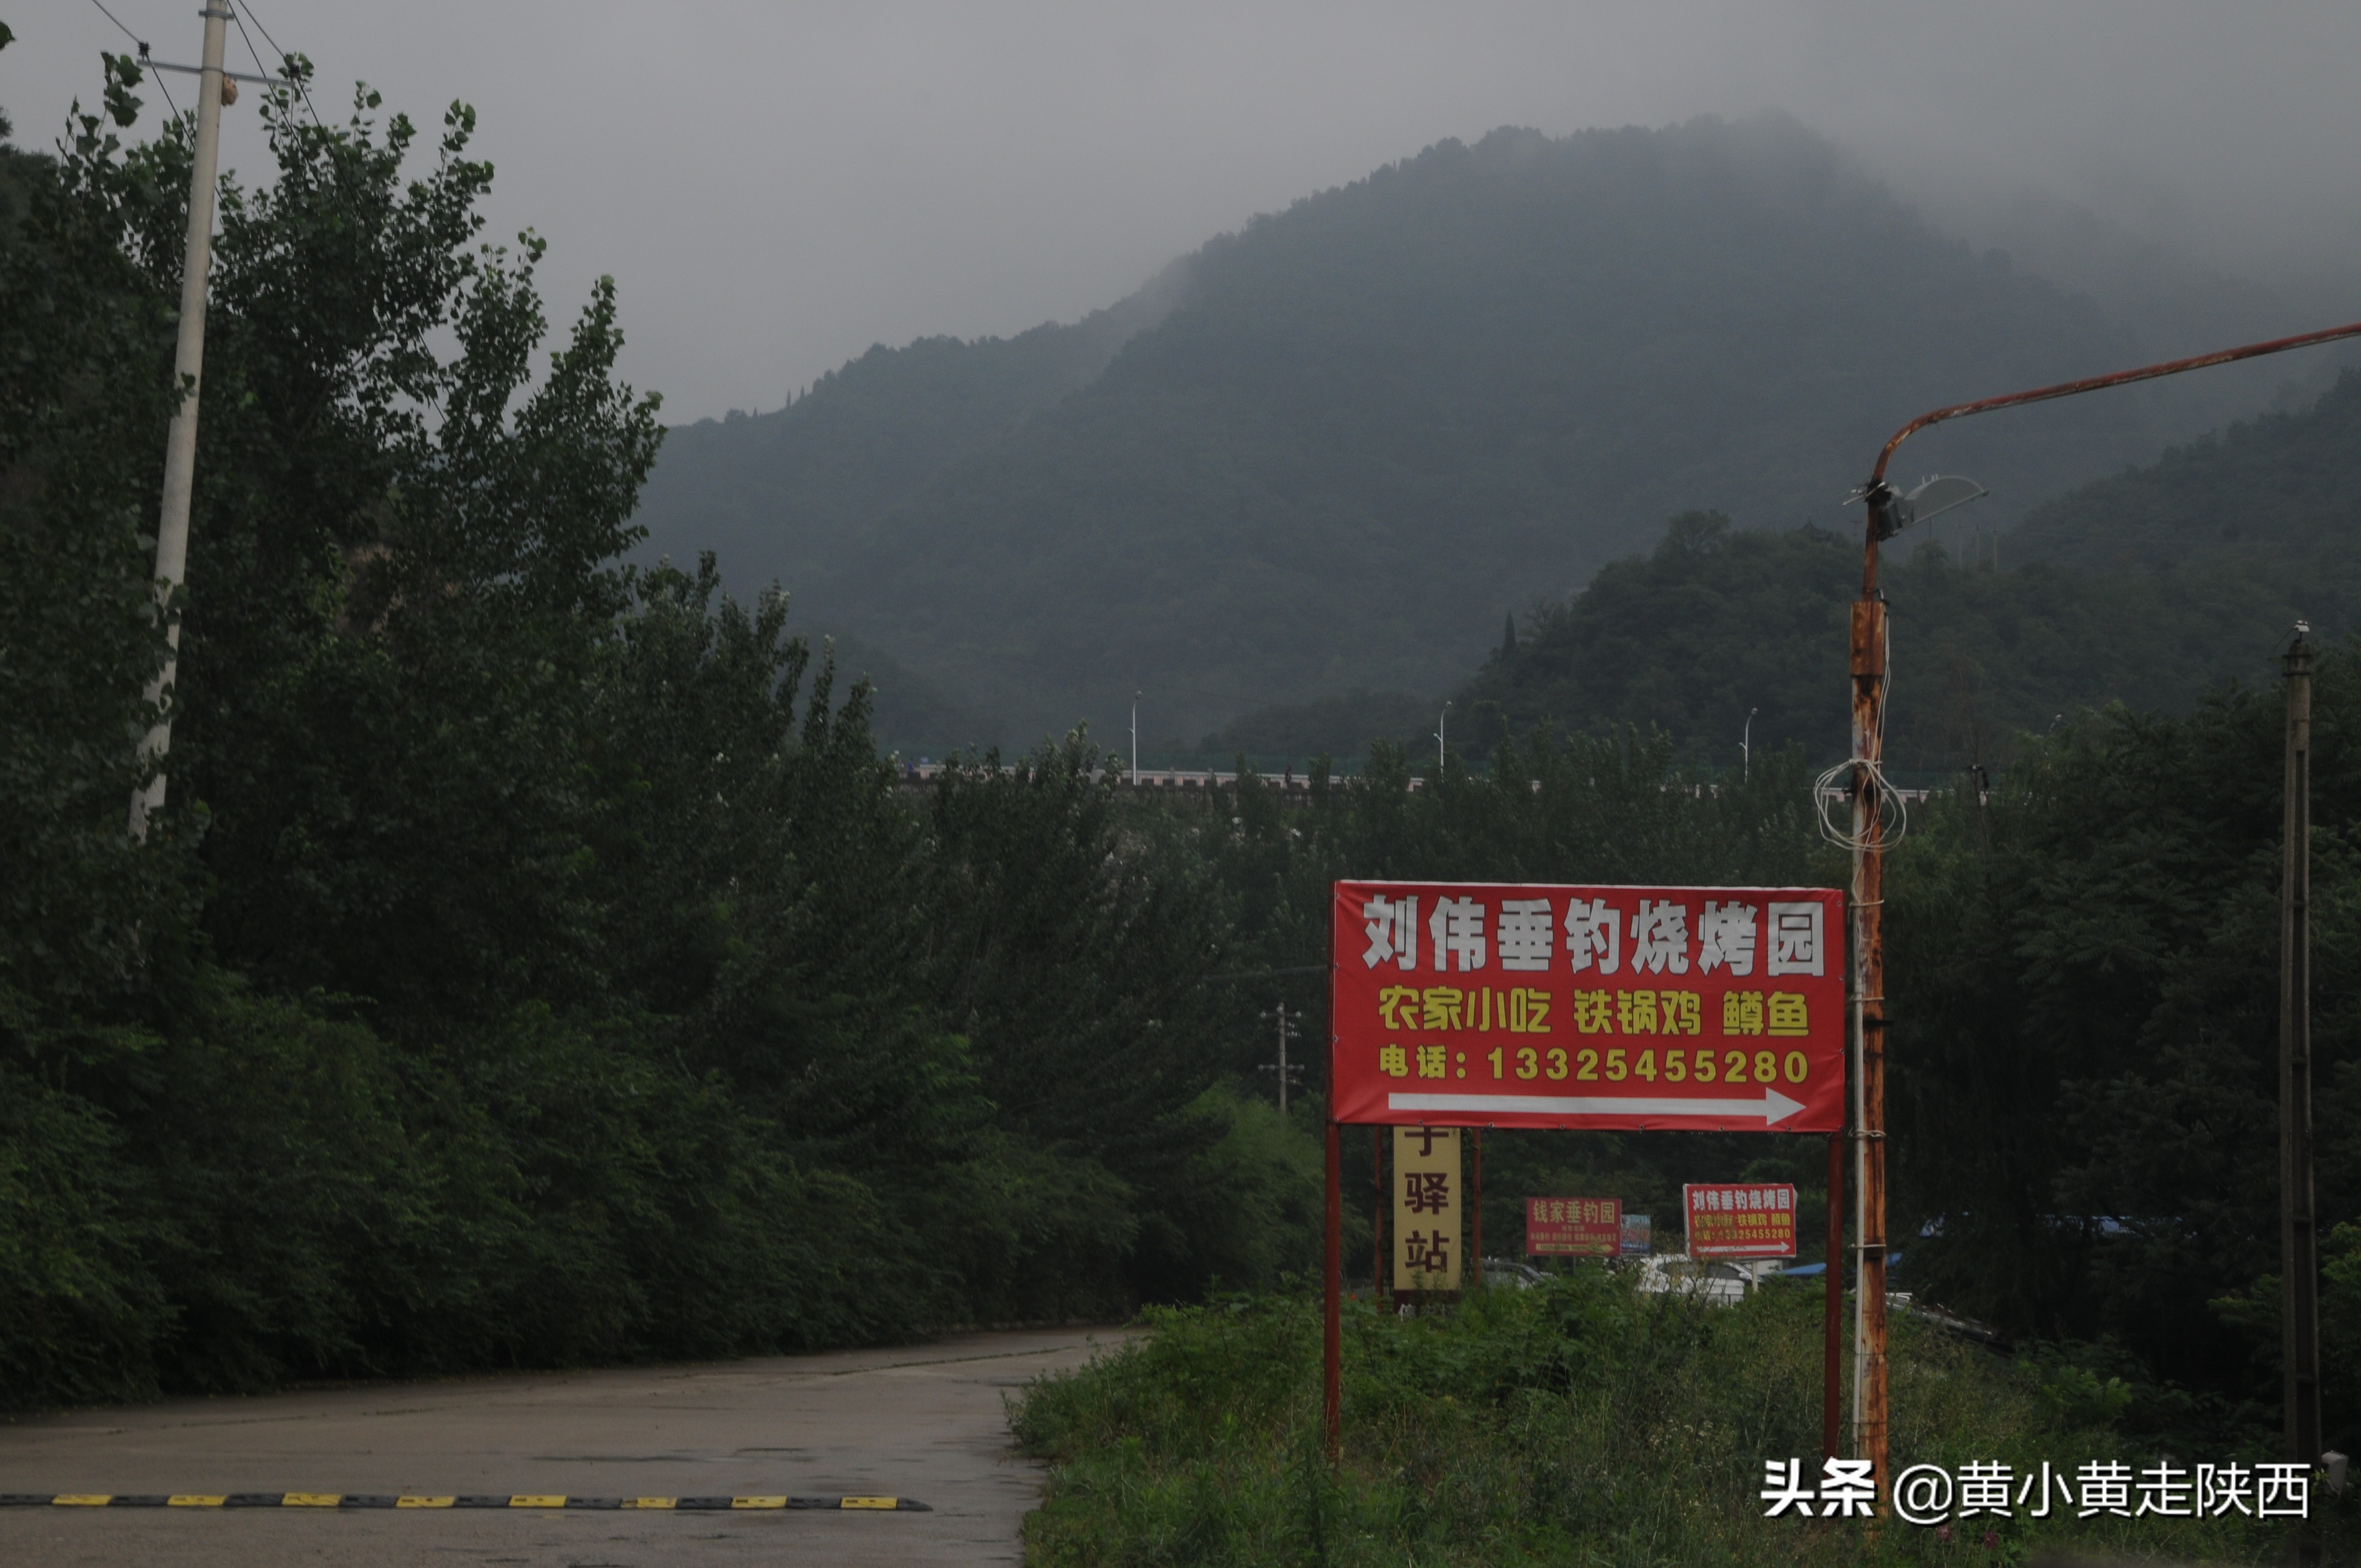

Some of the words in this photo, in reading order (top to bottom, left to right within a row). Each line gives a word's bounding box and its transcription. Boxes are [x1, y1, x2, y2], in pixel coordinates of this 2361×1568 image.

[1362, 894, 1825, 977] 刘伟垂钓烧烤园
[1378, 984, 1552, 1033] 农家小吃
[1573, 988, 1701, 1036] 铁锅鸡
[1722, 990, 1810, 1037] 鳟鱼
[1533, 1199, 1615, 1223] 钱家垂钓园
[1692, 1188, 1790, 1211] 刘伟垂钓烧烤园
